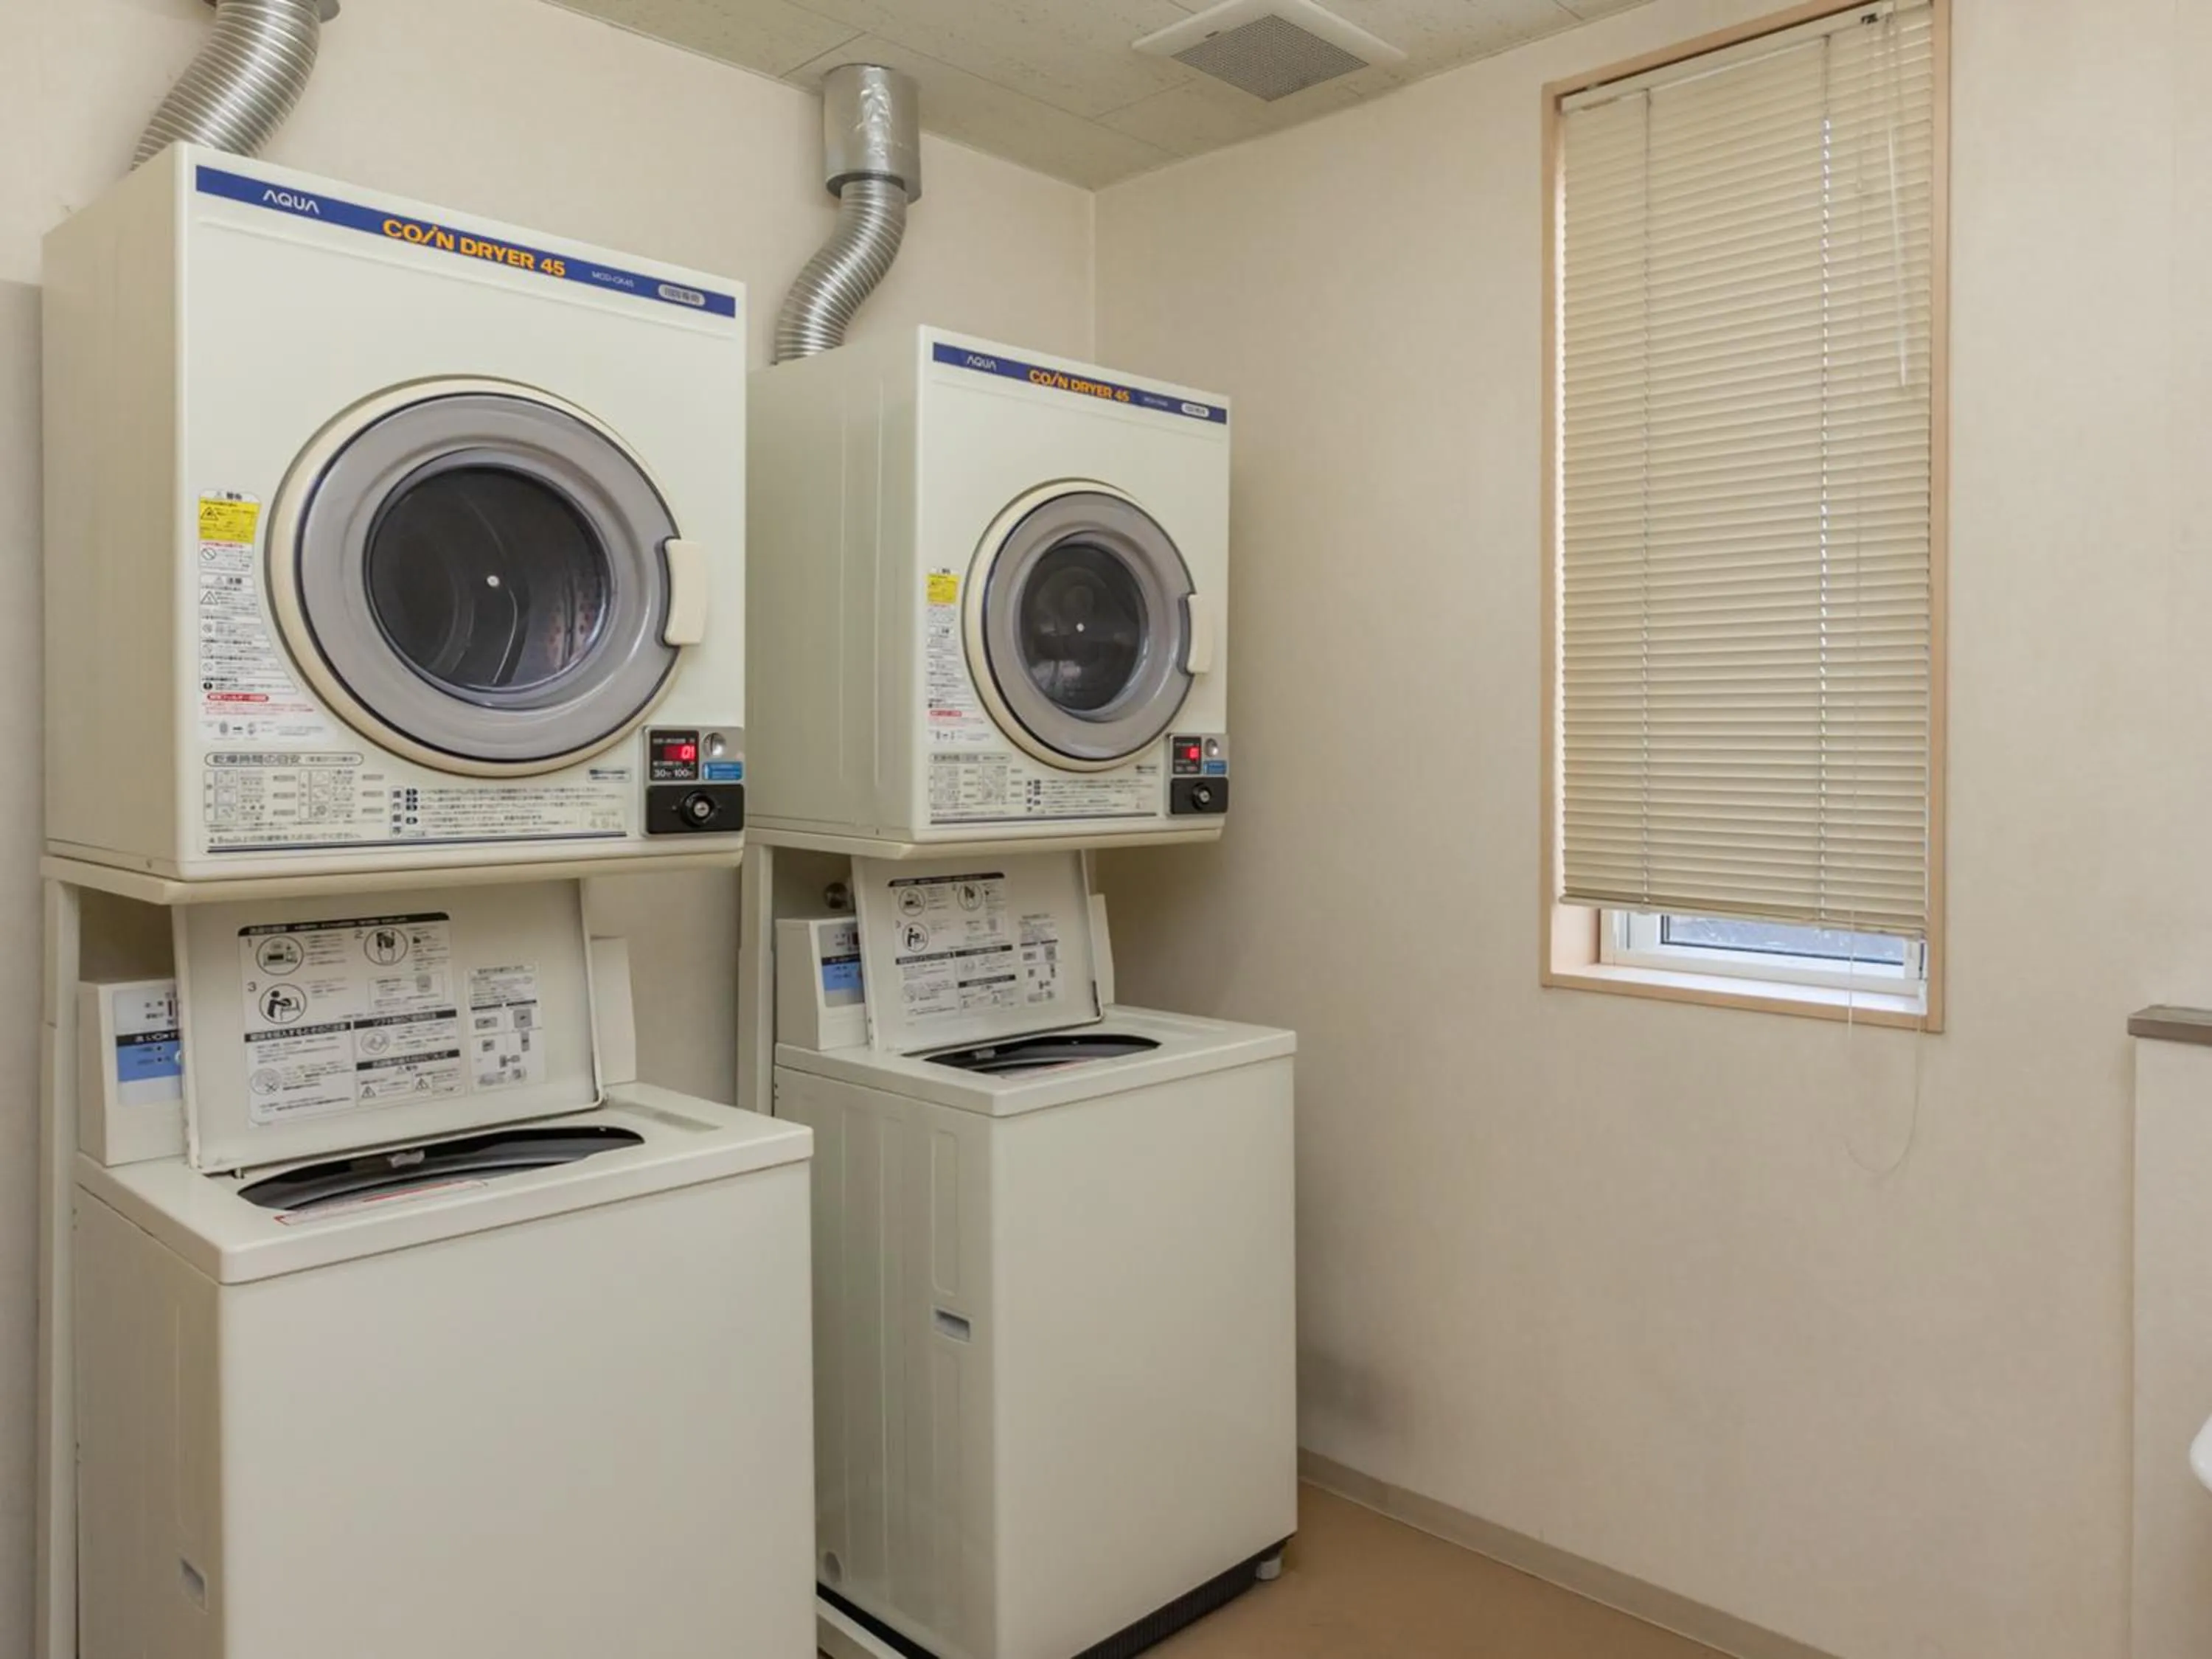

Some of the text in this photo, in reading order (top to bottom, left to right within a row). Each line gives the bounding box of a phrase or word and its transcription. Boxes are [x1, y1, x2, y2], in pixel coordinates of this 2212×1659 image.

[262, 189, 320, 215] AQUA
[459, 237, 535, 269] DRYER
[540, 258, 566, 278] 45
[967, 355, 997, 372] AQUA
[1071, 378, 1113, 399] DRYER
[1114, 389, 1130, 403] 45
